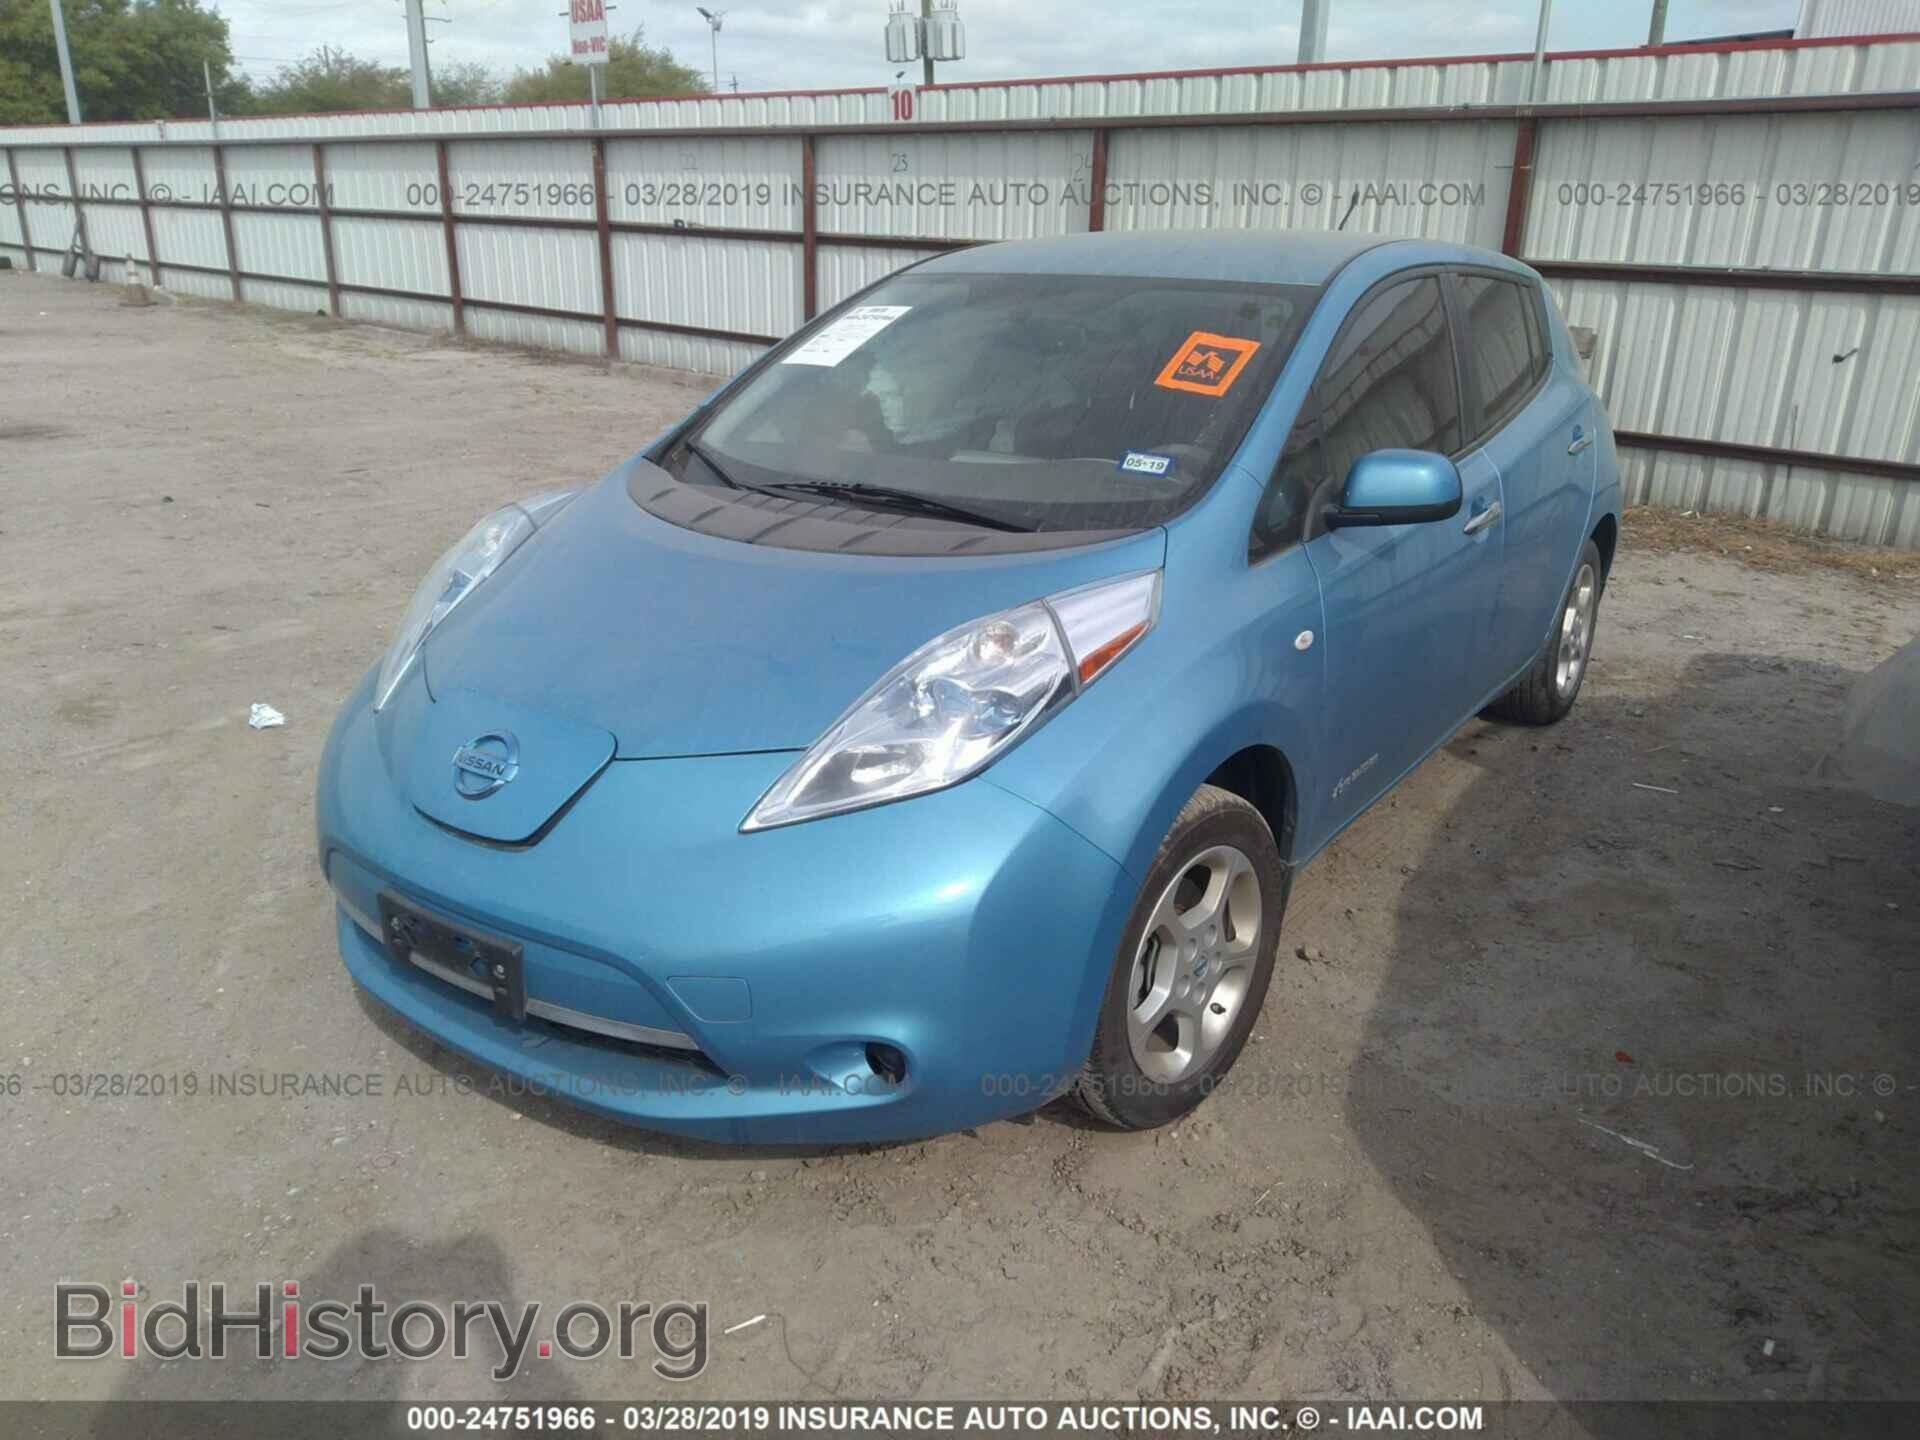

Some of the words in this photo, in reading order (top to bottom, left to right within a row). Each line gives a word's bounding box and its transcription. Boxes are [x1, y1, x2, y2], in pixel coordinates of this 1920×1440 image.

[891, 89, 914, 121] 10
[891, 152, 909, 173] 23
[1178, 366, 1215, 380] USAA
